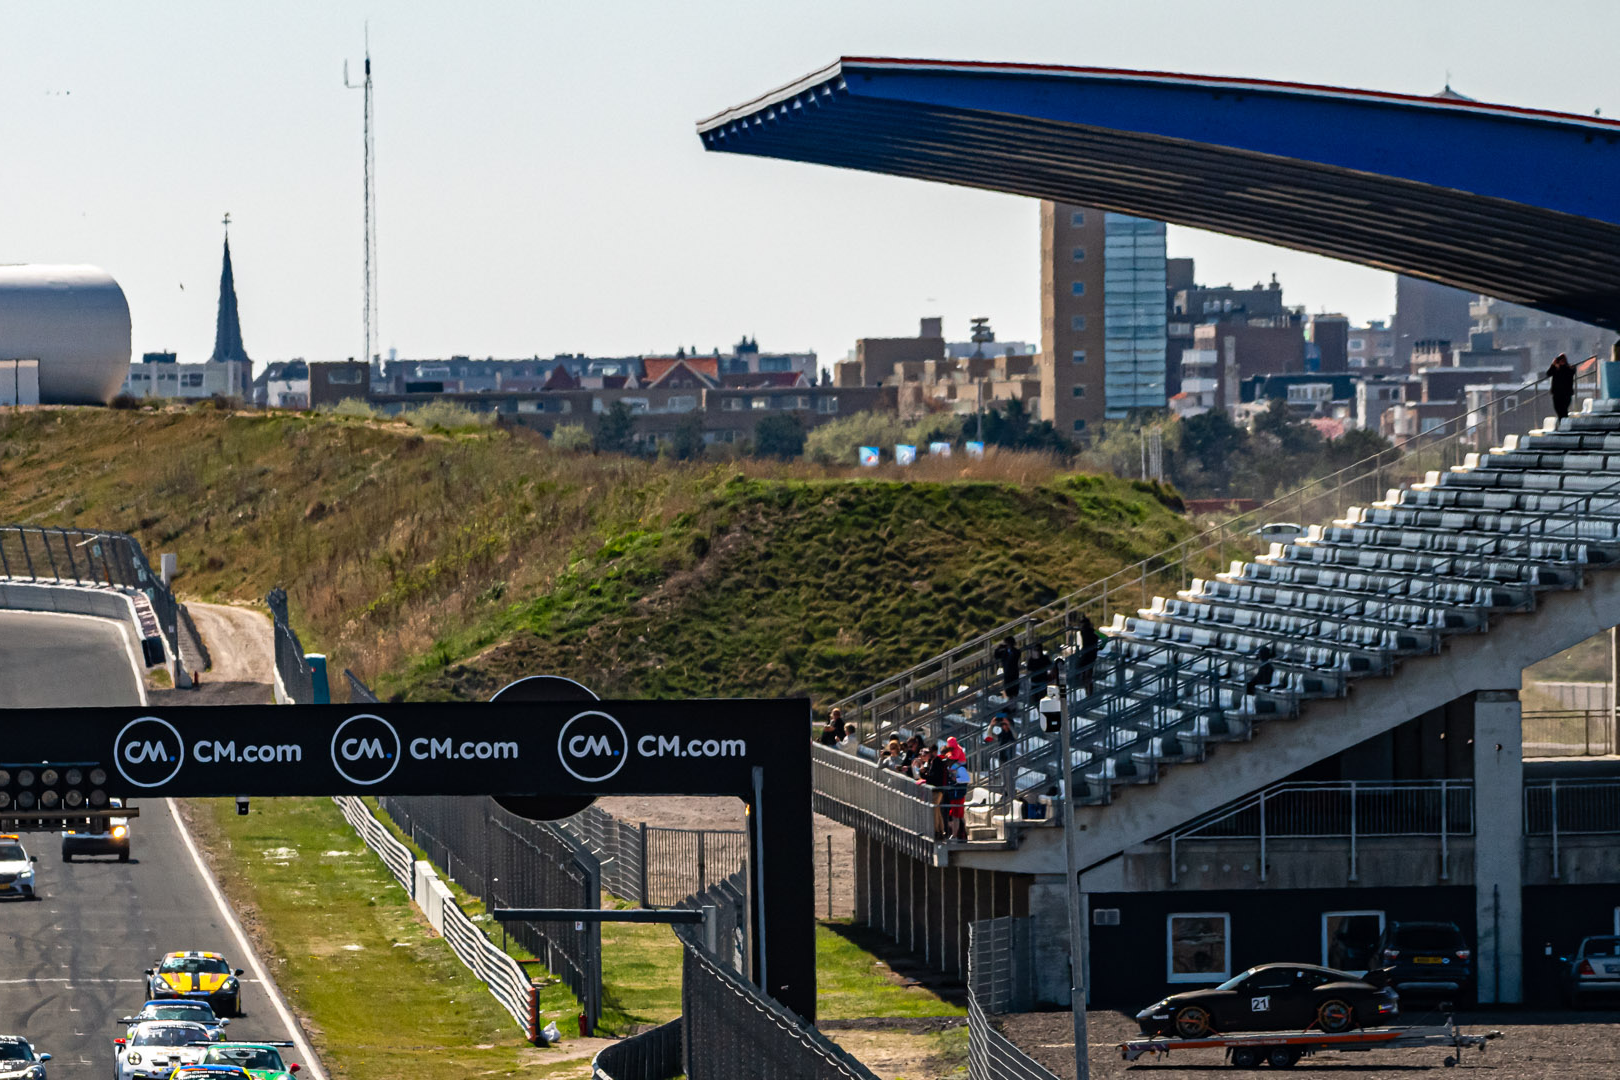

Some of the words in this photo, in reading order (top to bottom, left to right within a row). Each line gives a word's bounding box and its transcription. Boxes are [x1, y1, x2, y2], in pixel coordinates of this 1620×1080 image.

[193, 740, 302, 763] CM.com
[410, 737, 518, 760] CM.com
[637, 735, 746, 757] CM.com
[1252, 998, 1267, 1010] 21
